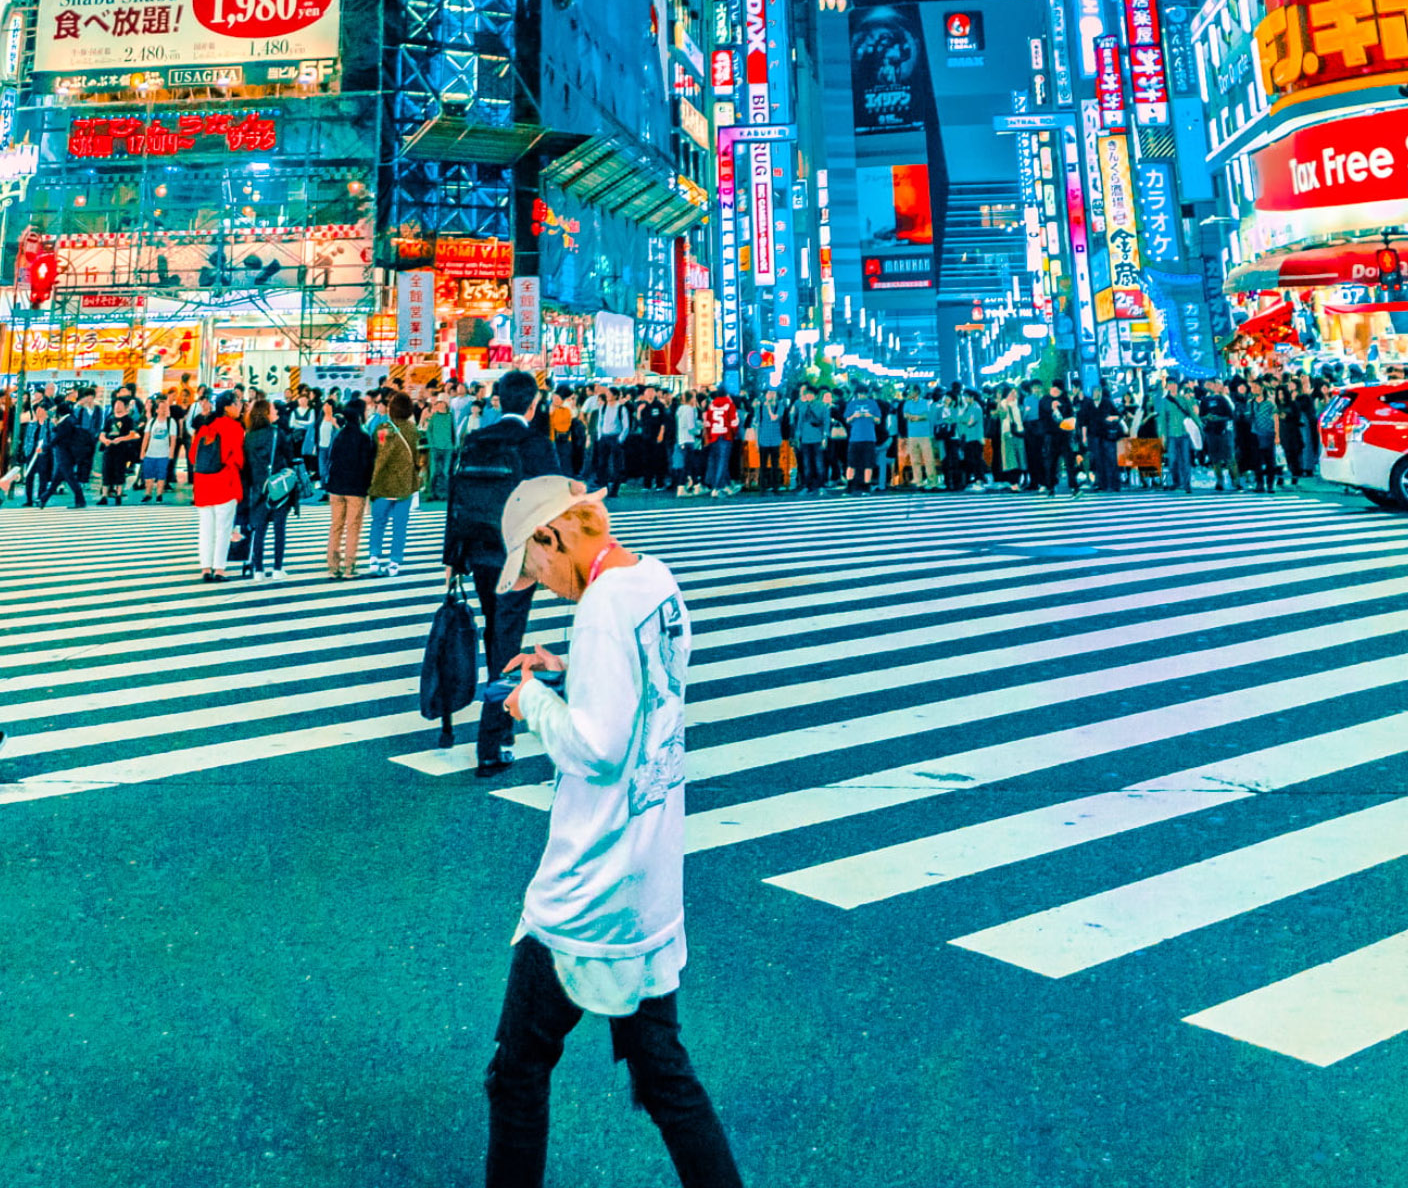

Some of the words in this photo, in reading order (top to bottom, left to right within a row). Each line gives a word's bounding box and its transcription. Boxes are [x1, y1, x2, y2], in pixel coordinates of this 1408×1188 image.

[298, 7, 319, 19] yen
[174, 68, 238, 84] USAGIYA
[299, 59, 335, 81] 5F
[752, 94, 765, 123] BIC
[1289, 157, 1321, 195] Tax
[1322, 145, 1394, 186] Free
[1145, 168, 1173, 254] カラオケ
[1110, 228, 1141, 287] 金の蔵
[711, 408, 729, 435] 5
